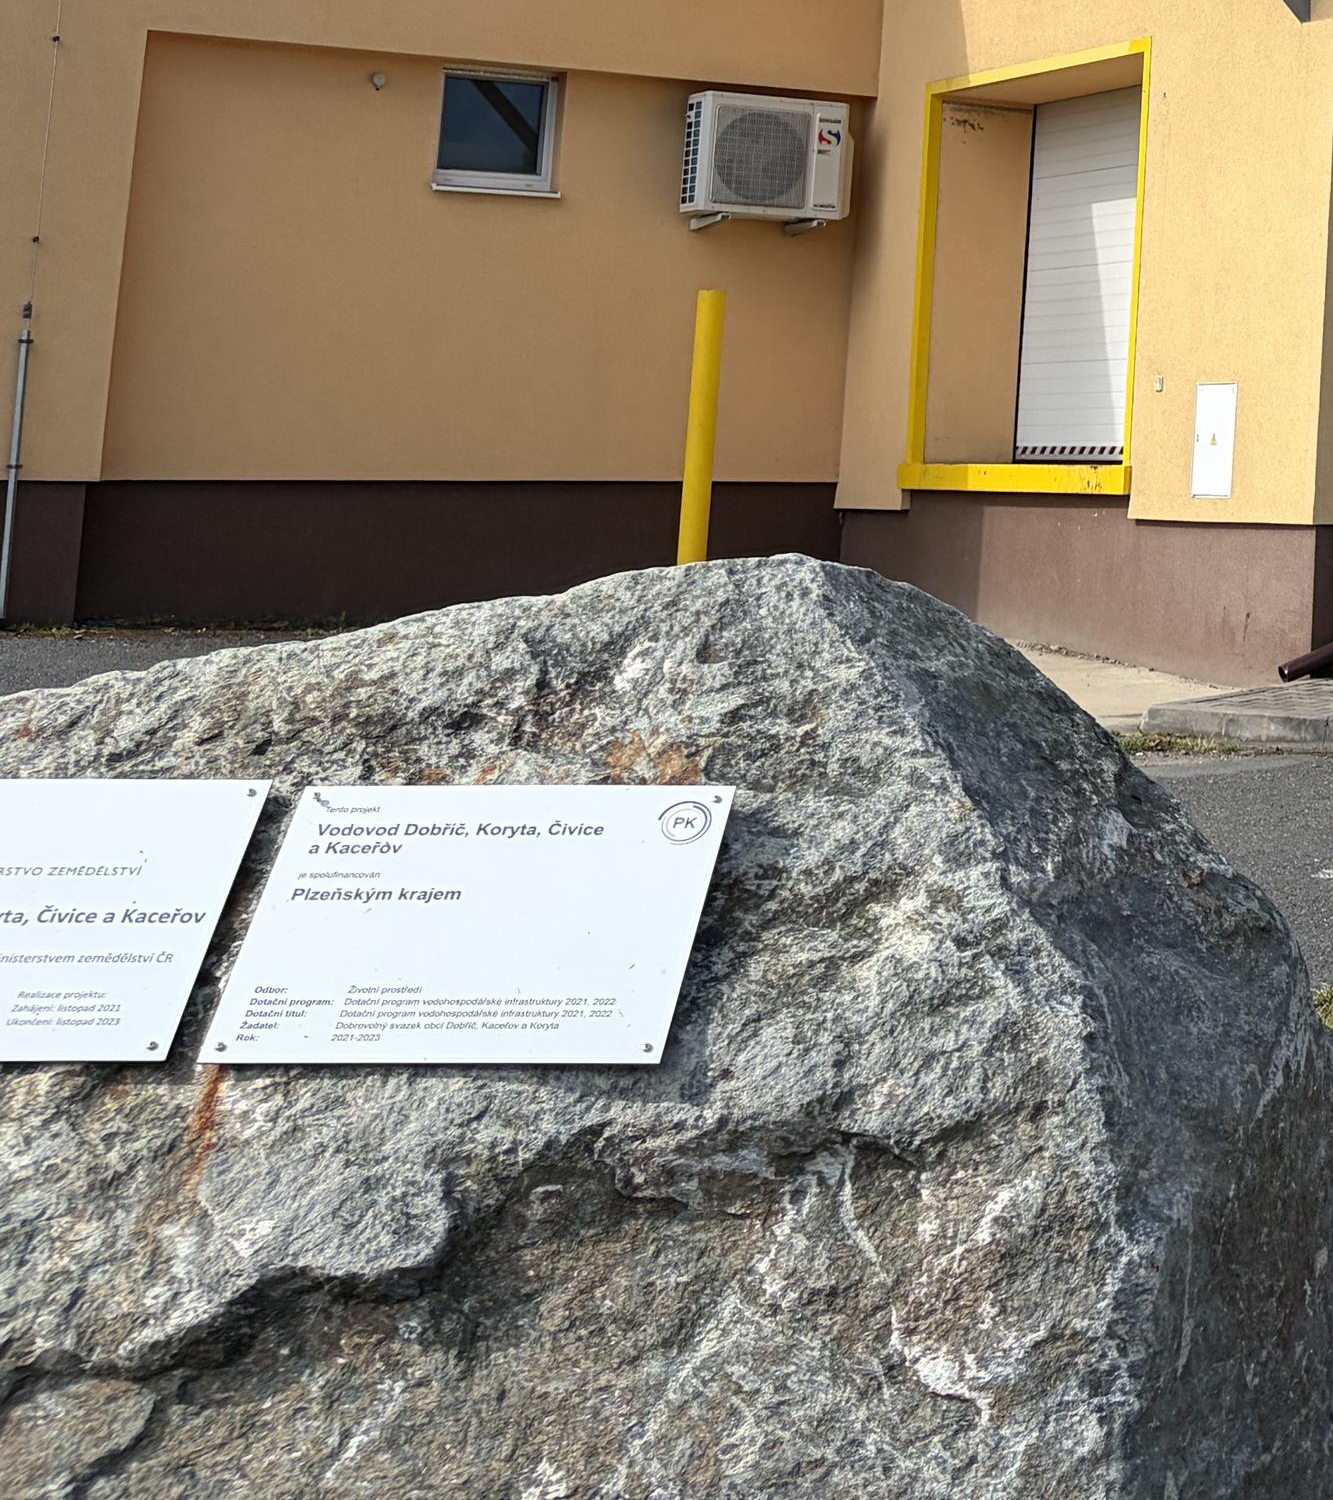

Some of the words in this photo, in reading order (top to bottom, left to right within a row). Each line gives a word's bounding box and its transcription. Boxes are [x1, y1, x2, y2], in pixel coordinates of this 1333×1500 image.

[350, 805, 380, 814] projekt
[673, 817, 698, 829] PK
[318, 823, 400, 836] Vodovod
[404, 823, 469, 838] Dobříč,
[476, 822, 542, 839] Koryta,
[548, 820, 604, 836] Čivice
[308, 844, 320, 854] a
[298, 871, 307, 880] je
[309, 871, 380, 880] spolufinancován
[291, 887, 392, 903] Plzeňským
[398, 887, 462, 903] krajem
[37, 905, 98, 924] Čivice
[103, 911, 116, 924] a
[121, 907, 206, 924] Kaceřov
[77, 952, 154, 963] zemědělství
[156, 951, 173, 963] ČR
[254, 986, 288, 994] Odbor:
[18, 991, 62, 999] Realizace
[250, 998, 287, 1006] Dotační
[289, 999, 334, 1007] program:
[344, 998, 381, 1006] Dotační
[381, 999, 420, 1007] program
[565, 998, 589, 1006] 2021,
[593, 998, 616, 1006] 2022
[57, 1004, 95, 1013] listopad
[98, 1004, 121, 1012] 2021
[339, 1010, 376, 1018] Dotační
[377, 1011, 416, 1019] program
[561, 1010, 586, 1018] 2021,
[589, 1010, 613, 1018] 2022
[56, 1017, 95, 1027] listopad
[96, 1018, 120, 1026] 2023
[235, 1034, 260, 1042] Rok:
[331, 1034, 381, 1042] 2021-2023
